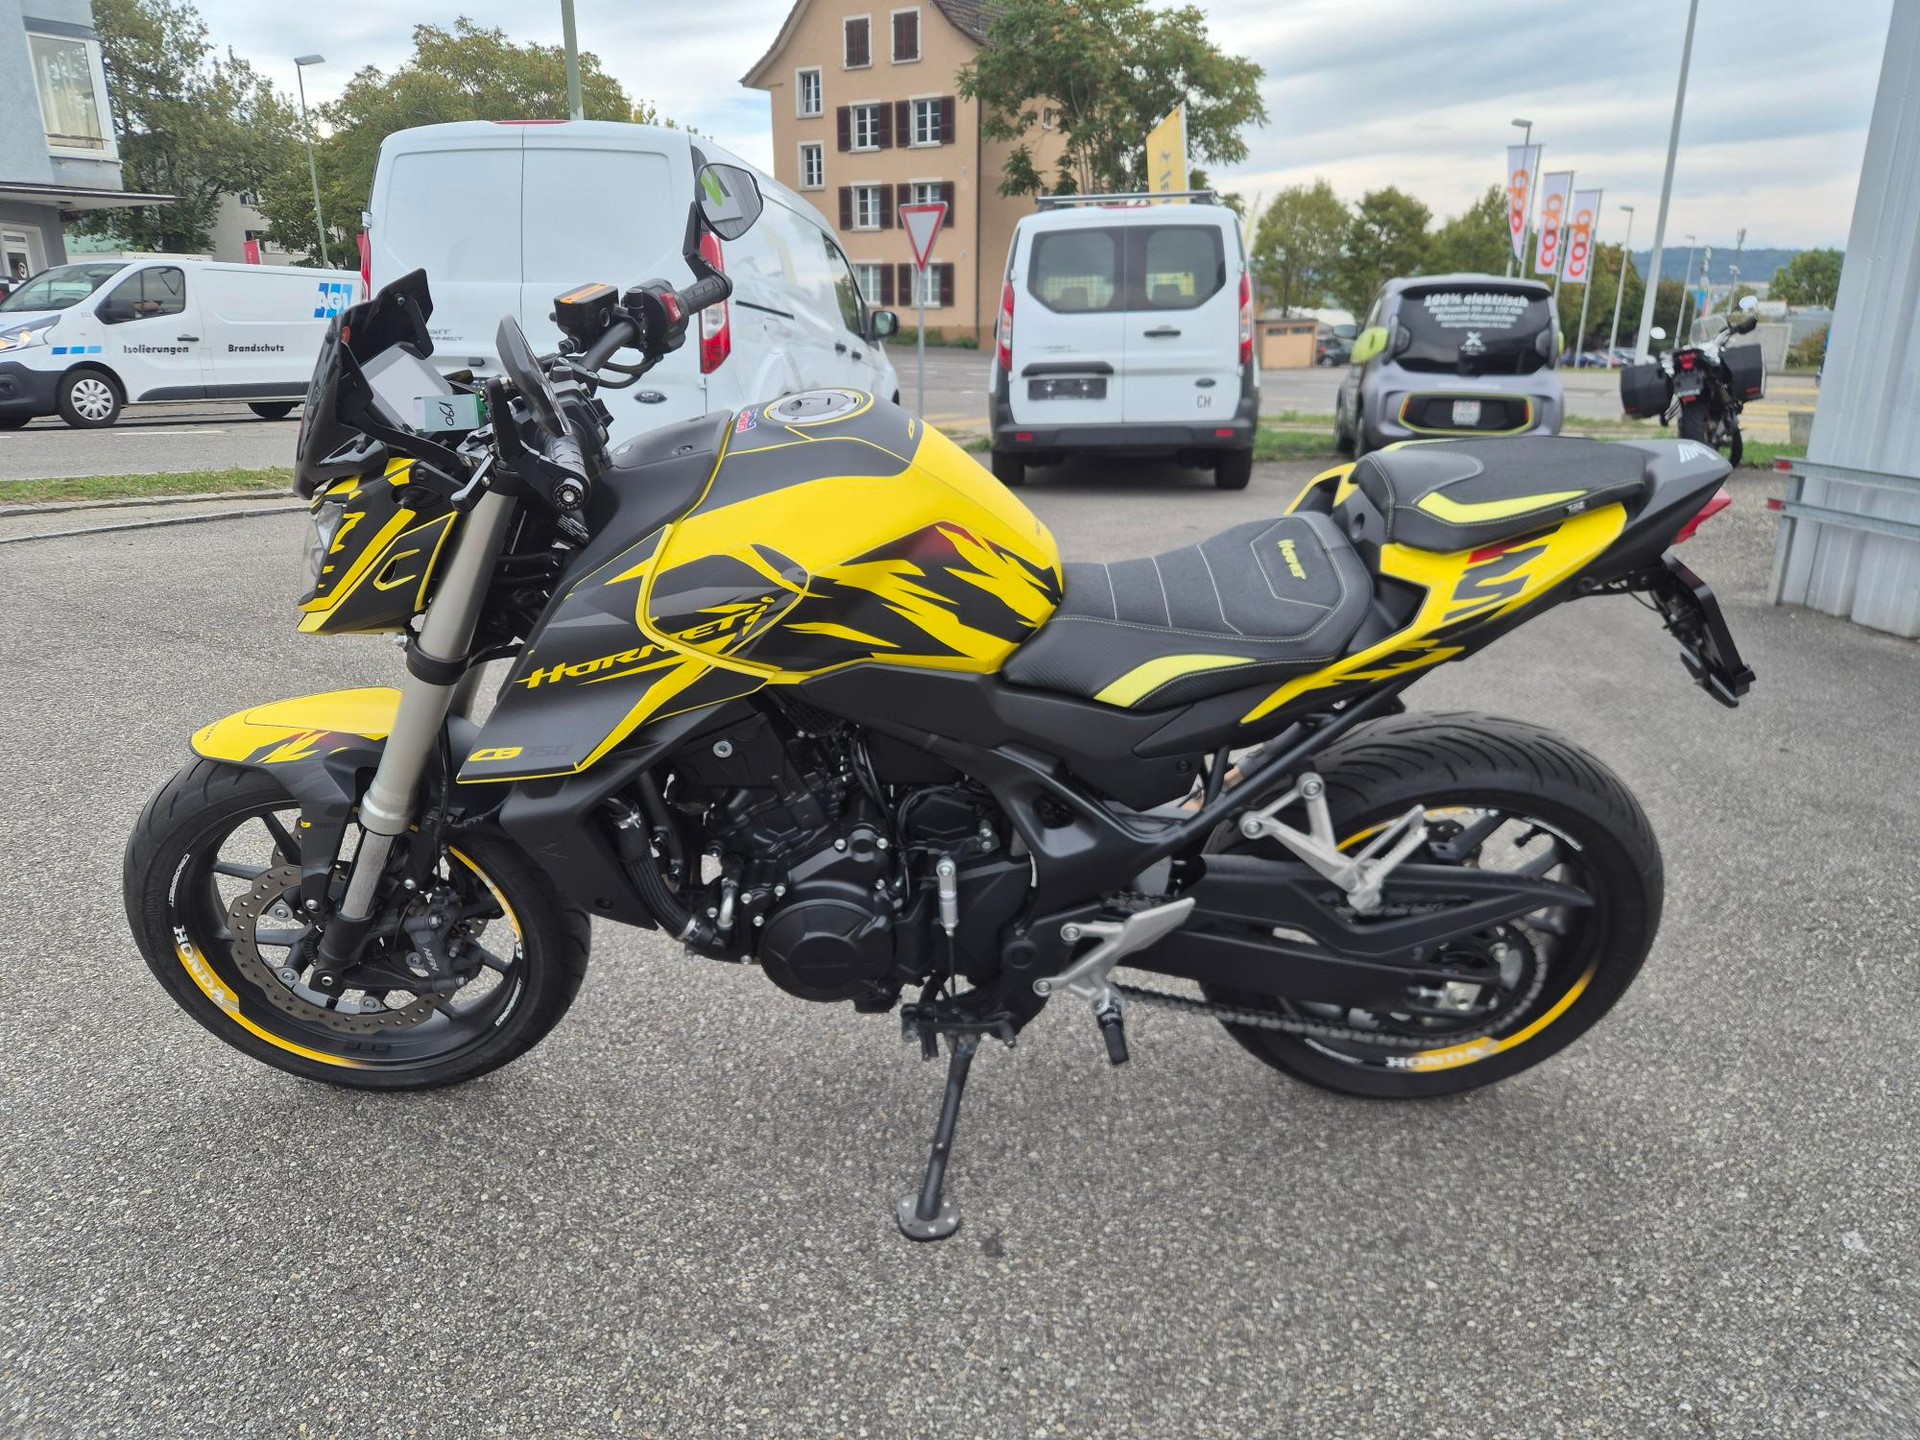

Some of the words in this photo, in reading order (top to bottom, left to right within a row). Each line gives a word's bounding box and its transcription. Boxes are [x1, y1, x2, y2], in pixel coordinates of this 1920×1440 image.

[1508, 168, 1530, 234] oop
[1540, 193, 1563, 268] coop
[1568, 208, 1593, 277] coop
[1424, 293, 1461, 307] 100%
[1463, 292, 1529, 308] elektrisch
[123, 344, 189, 355] Isolierungen
[228, 343, 285, 352] Brandschutz
[1196, 395, 1211, 409] CH
[468, 746, 524, 762] CB
[526, 744, 574, 758] 750
[172, 925, 227, 1004] HONDA
[1385, 1046, 1483, 1069] HONDA
